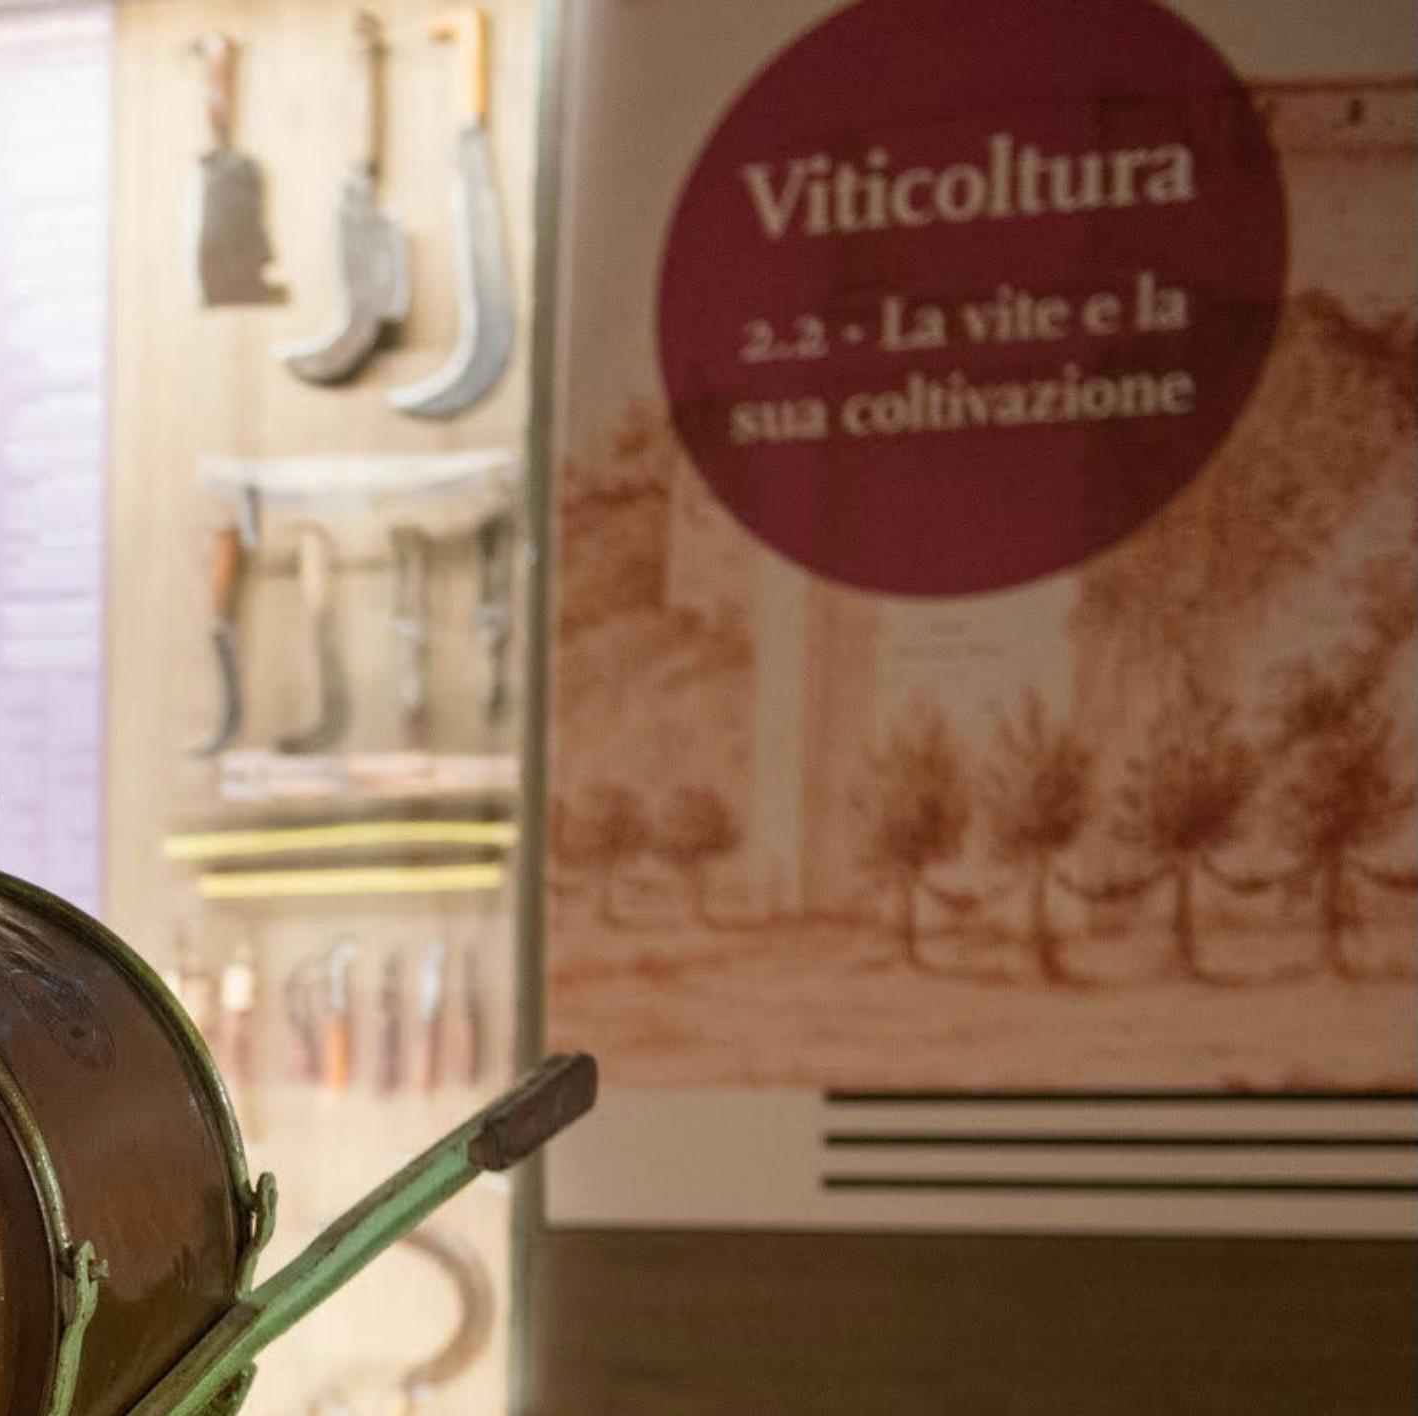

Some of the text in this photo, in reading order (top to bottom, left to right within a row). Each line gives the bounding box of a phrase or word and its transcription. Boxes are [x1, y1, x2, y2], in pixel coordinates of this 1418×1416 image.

[743, 132, 1197, 240] Viticoltura
[740, 314, 829, 364] 2.2
[881, 295, 947, 352] La
[965, 282, 1070, 344] vite
[1083, 291, 1121, 334] e
[1136, 271, 1190, 331] la
[730, 363, 1197, 446] sua coltivazione
